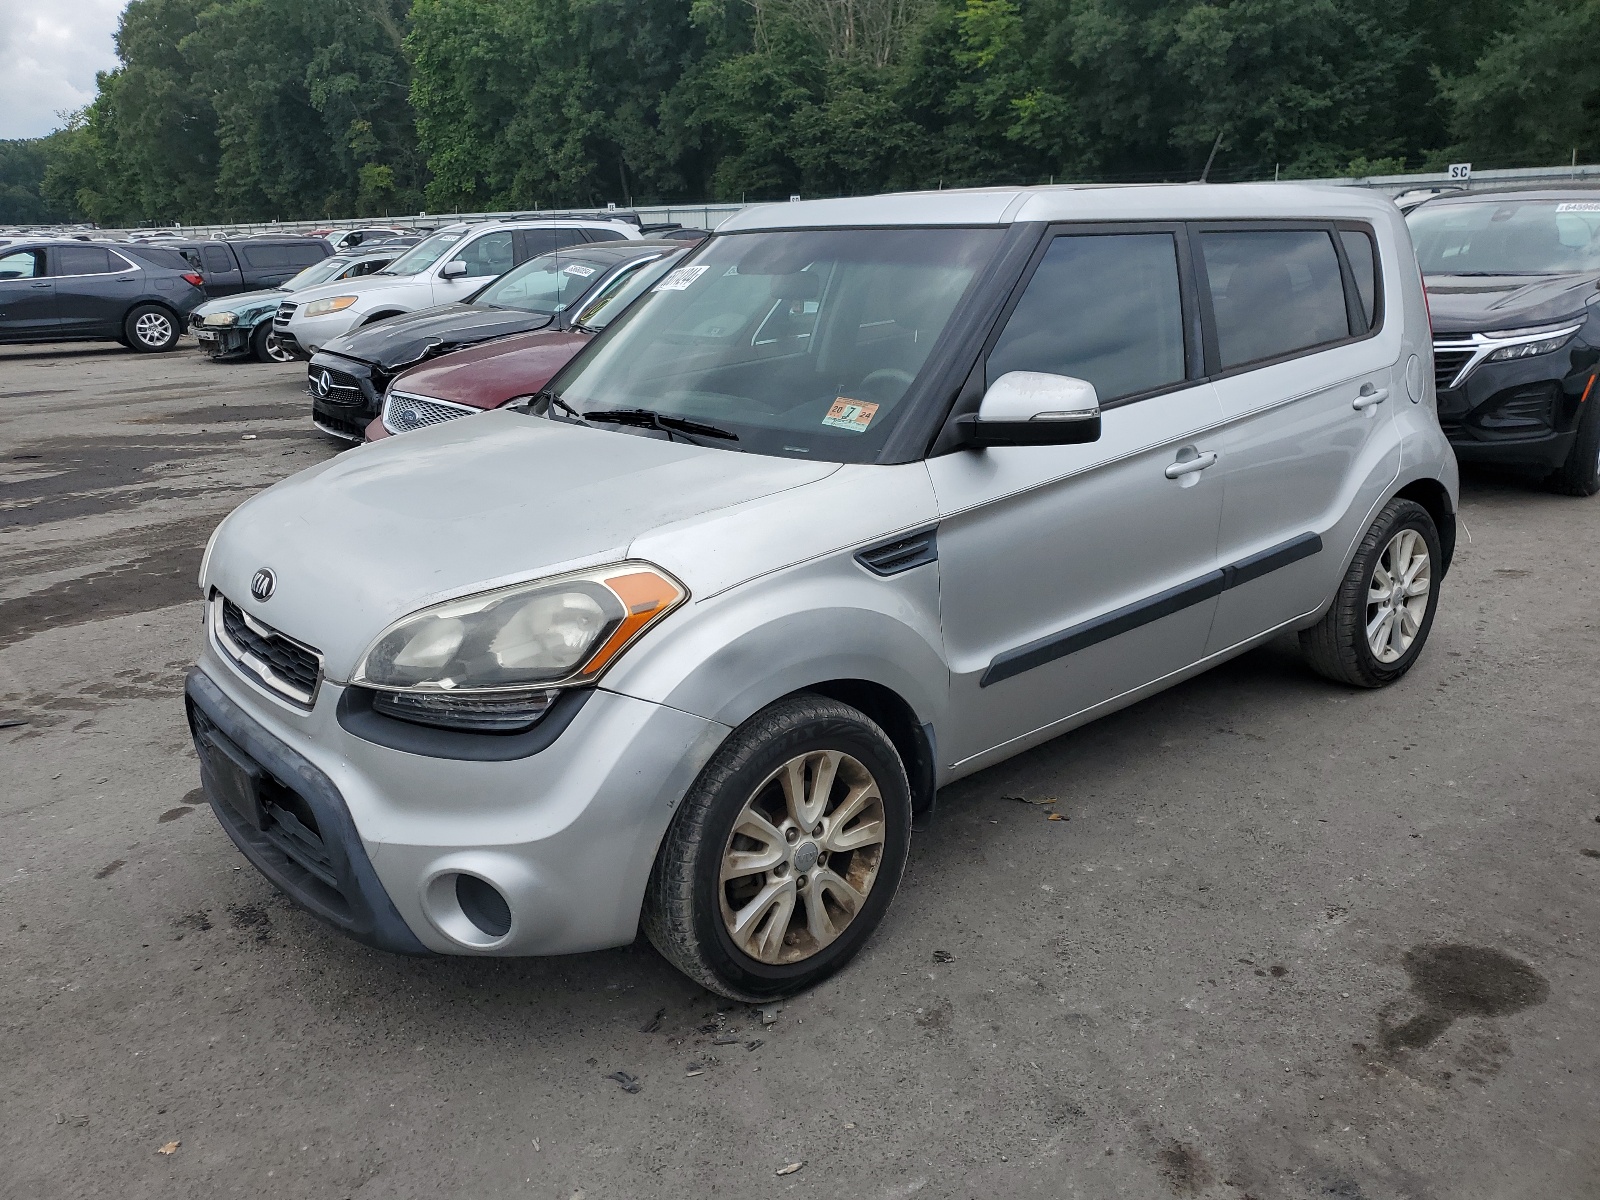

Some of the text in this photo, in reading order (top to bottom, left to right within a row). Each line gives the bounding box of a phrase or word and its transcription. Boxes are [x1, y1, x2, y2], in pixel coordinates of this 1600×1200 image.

[1451, 166, 1468, 178] SC
[832, 405, 872, 419] 20 7 24
[251, 572, 270, 596] KIA
